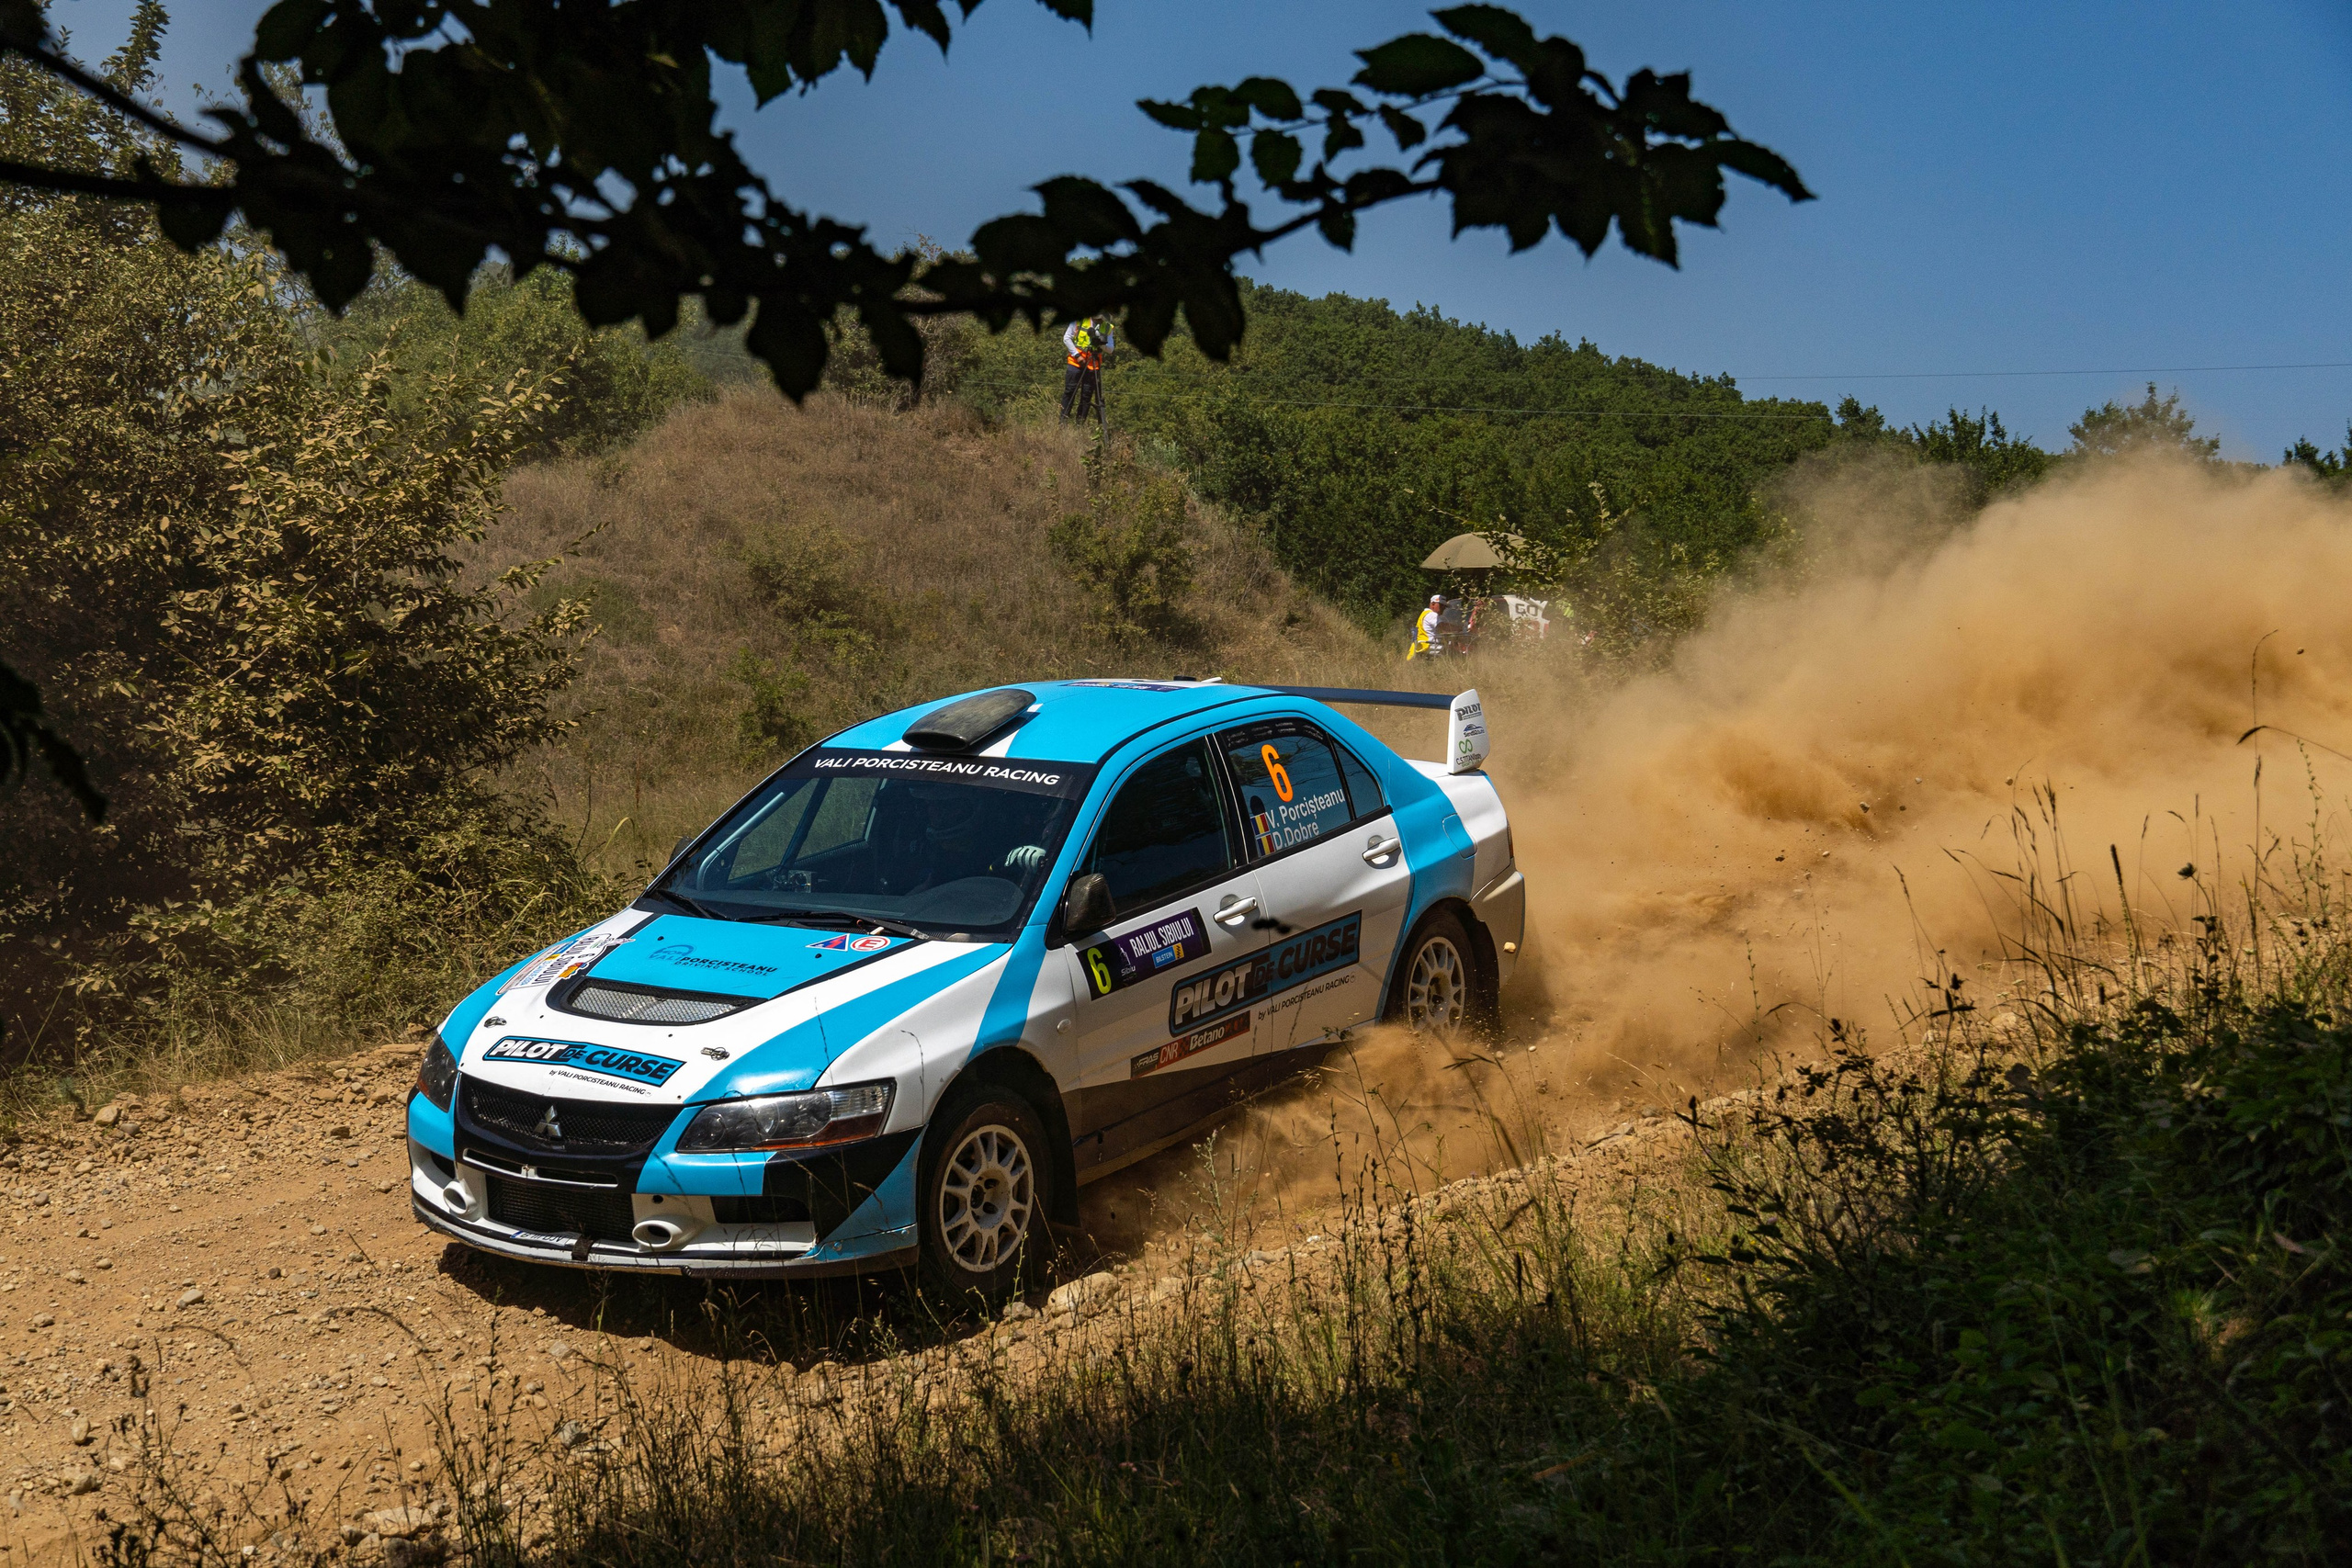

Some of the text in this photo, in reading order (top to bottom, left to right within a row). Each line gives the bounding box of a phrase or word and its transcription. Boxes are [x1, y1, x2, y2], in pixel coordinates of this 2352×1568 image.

[814, 758, 1060, 785] VALI PORCISTEANU RACING
[1261, 744, 1294, 802] 6
[1265, 788, 1346, 829] V. Porcișteanu
[858, 939, 881, 950] E
[1129, 917, 1194, 957] RALIUL SIBIULUI
[673, 961, 767, 976] DRIVING SCHOOL
[680, 956, 778, 973] PORCISTEANU
[1087, 947, 1112, 994] 6
[1156, 951, 1173, 964] BILSTEIN
[1174, 921, 1358, 1025] PILOT DE CURSE
[1258, 975, 1350, 1021] by VALI PORCISTEANU RACING
[489, 1039, 675, 1079] PILOT DE CURSE
[1159, 1042, 1179, 1064] CNR
[1189, 1026, 1225, 1051] Betano
[558, 1070, 573, 1079] VALI
[572, 1073, 619, 1089] PORCISTEANU
[619, 1083, 646, 1095] RACING
